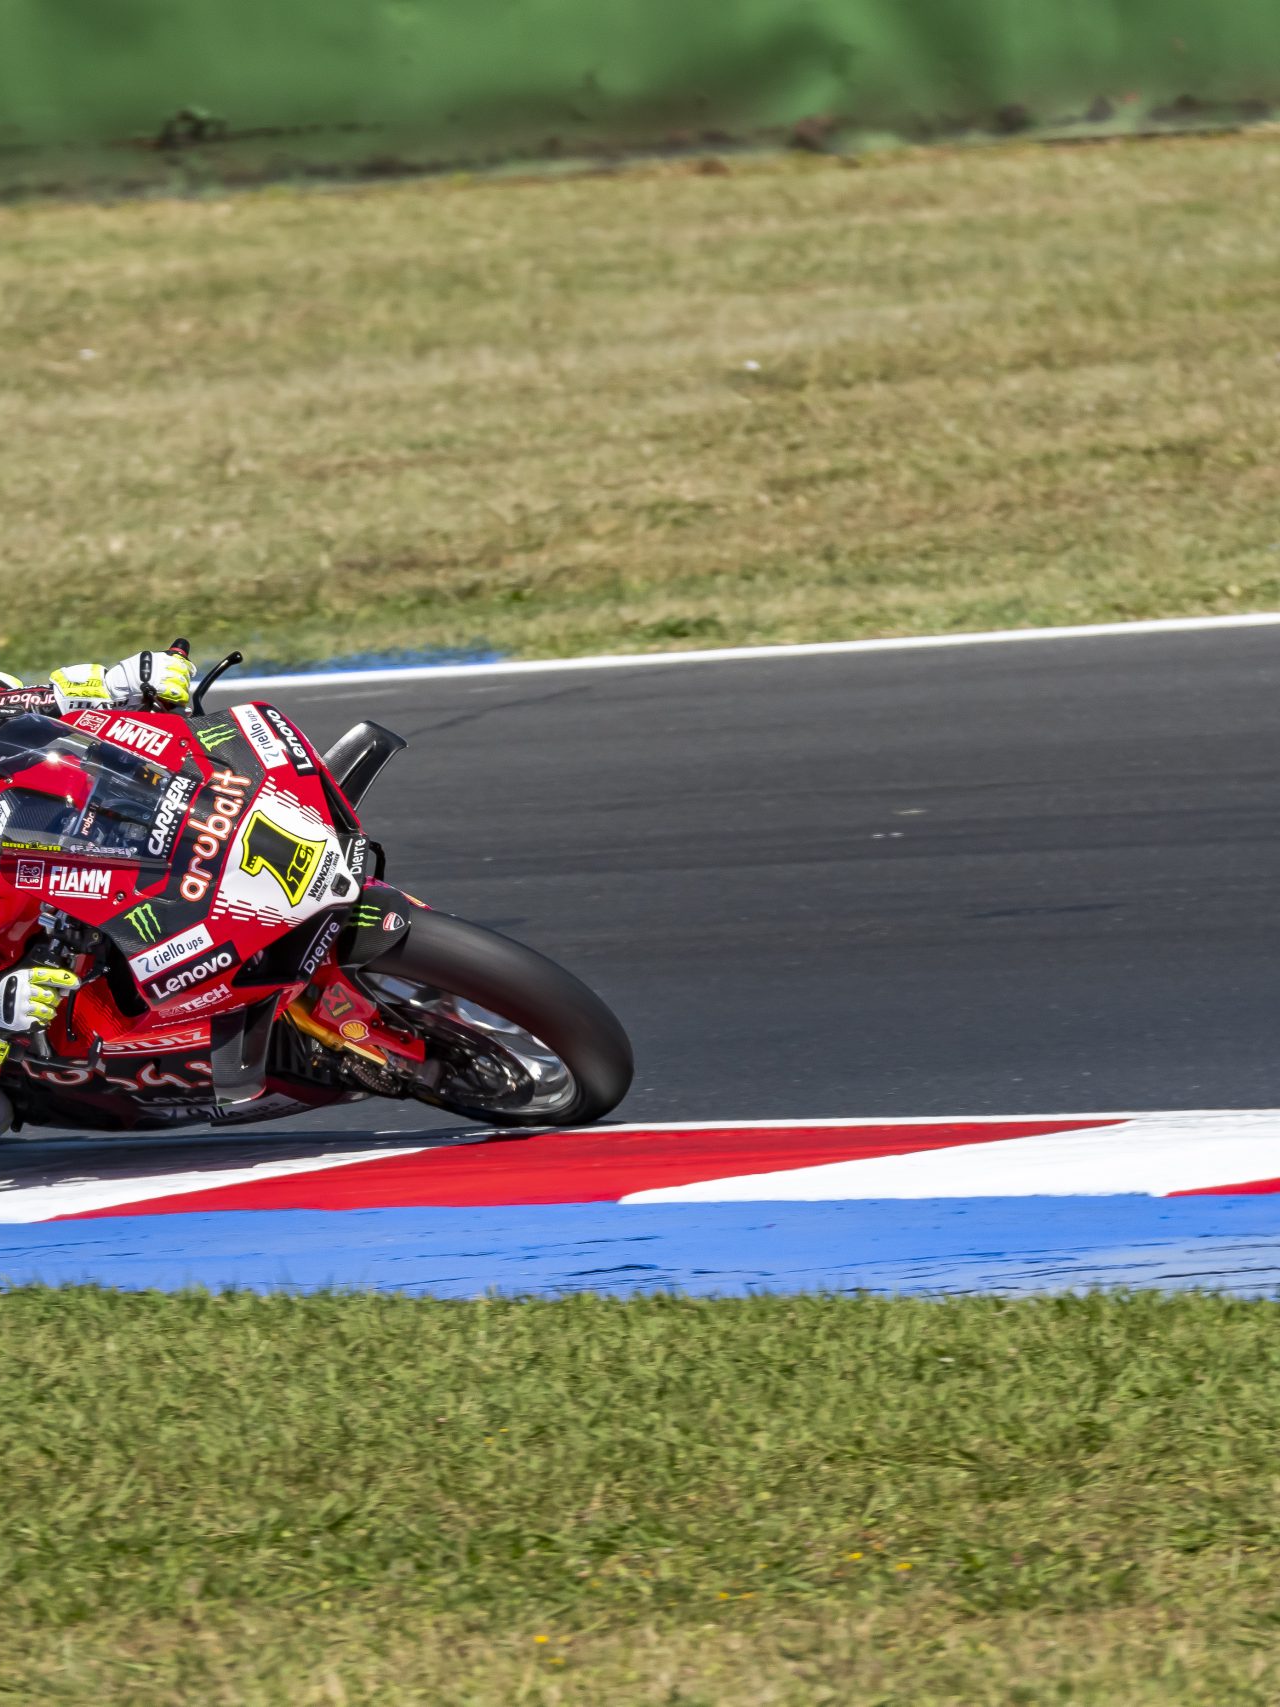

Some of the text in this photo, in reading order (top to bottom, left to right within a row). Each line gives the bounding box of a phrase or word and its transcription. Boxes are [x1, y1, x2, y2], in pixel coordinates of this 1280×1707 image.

[106, 719, 171, 757] FIAMM
[244, 709, 273, 752] riello ups
[266, 709, 314, 770] Lenovo
[147, 775, 191, 856] CARRERA
[180, 769, 251, 901] aruba.it
[49, 866, 112, 894] FIAMM
[240, 810, 327, 907] 1
[308, 850, 335, 898] WDW2024
[153, 935, 204, 967] riello ups
[151, 951, 233, 1000] Lenovo
